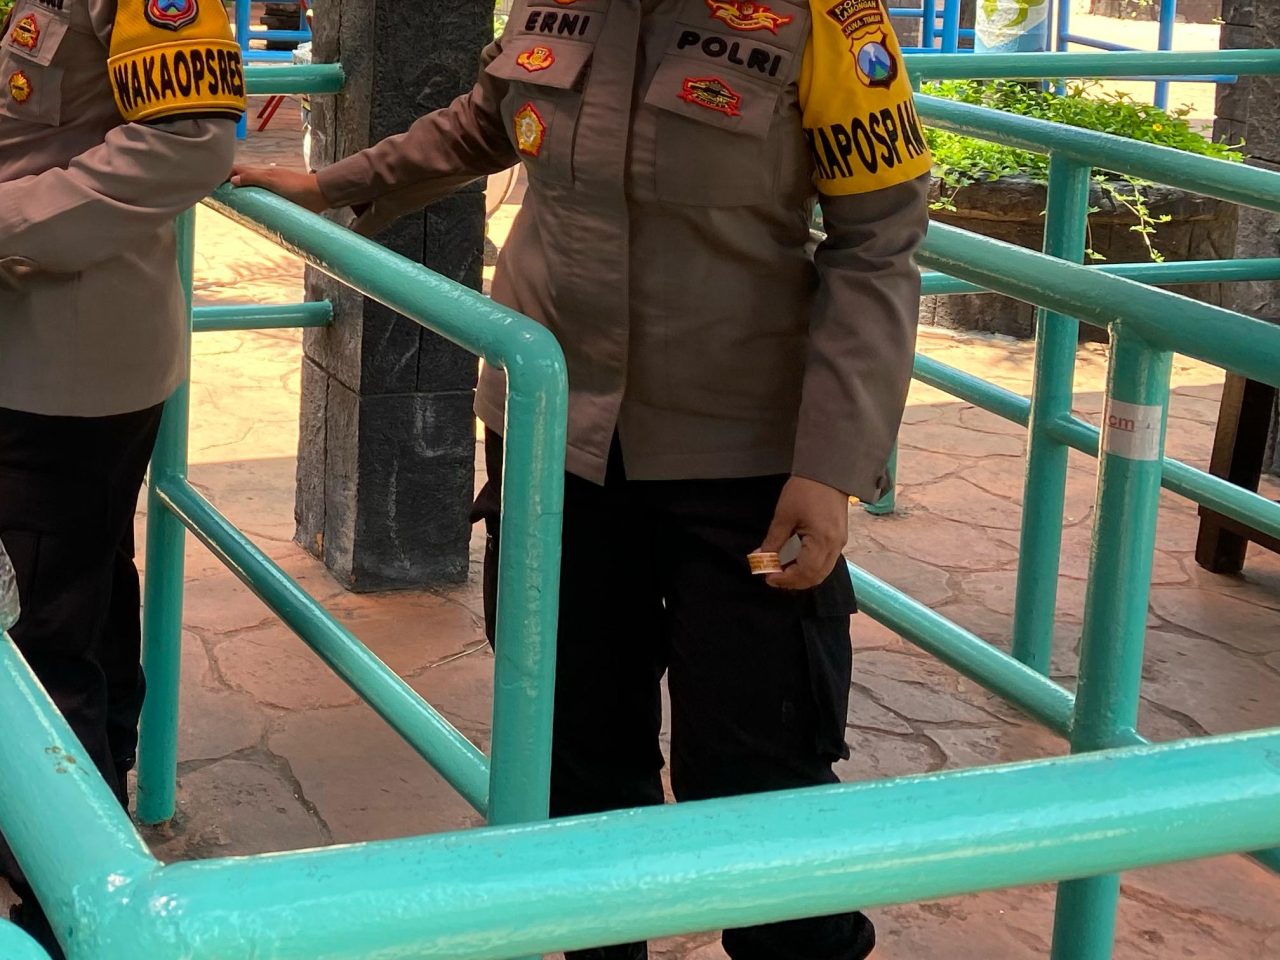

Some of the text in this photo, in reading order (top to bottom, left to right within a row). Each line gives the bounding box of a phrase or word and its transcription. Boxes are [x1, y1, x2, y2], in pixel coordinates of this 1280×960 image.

[524, 10, 591, 36] ERNI
[838, 1, 877, 21] LAMONGAN
[677, 30, 782, 77] POLRI
[113, 48, 243, 113] WAKAOPSRES
